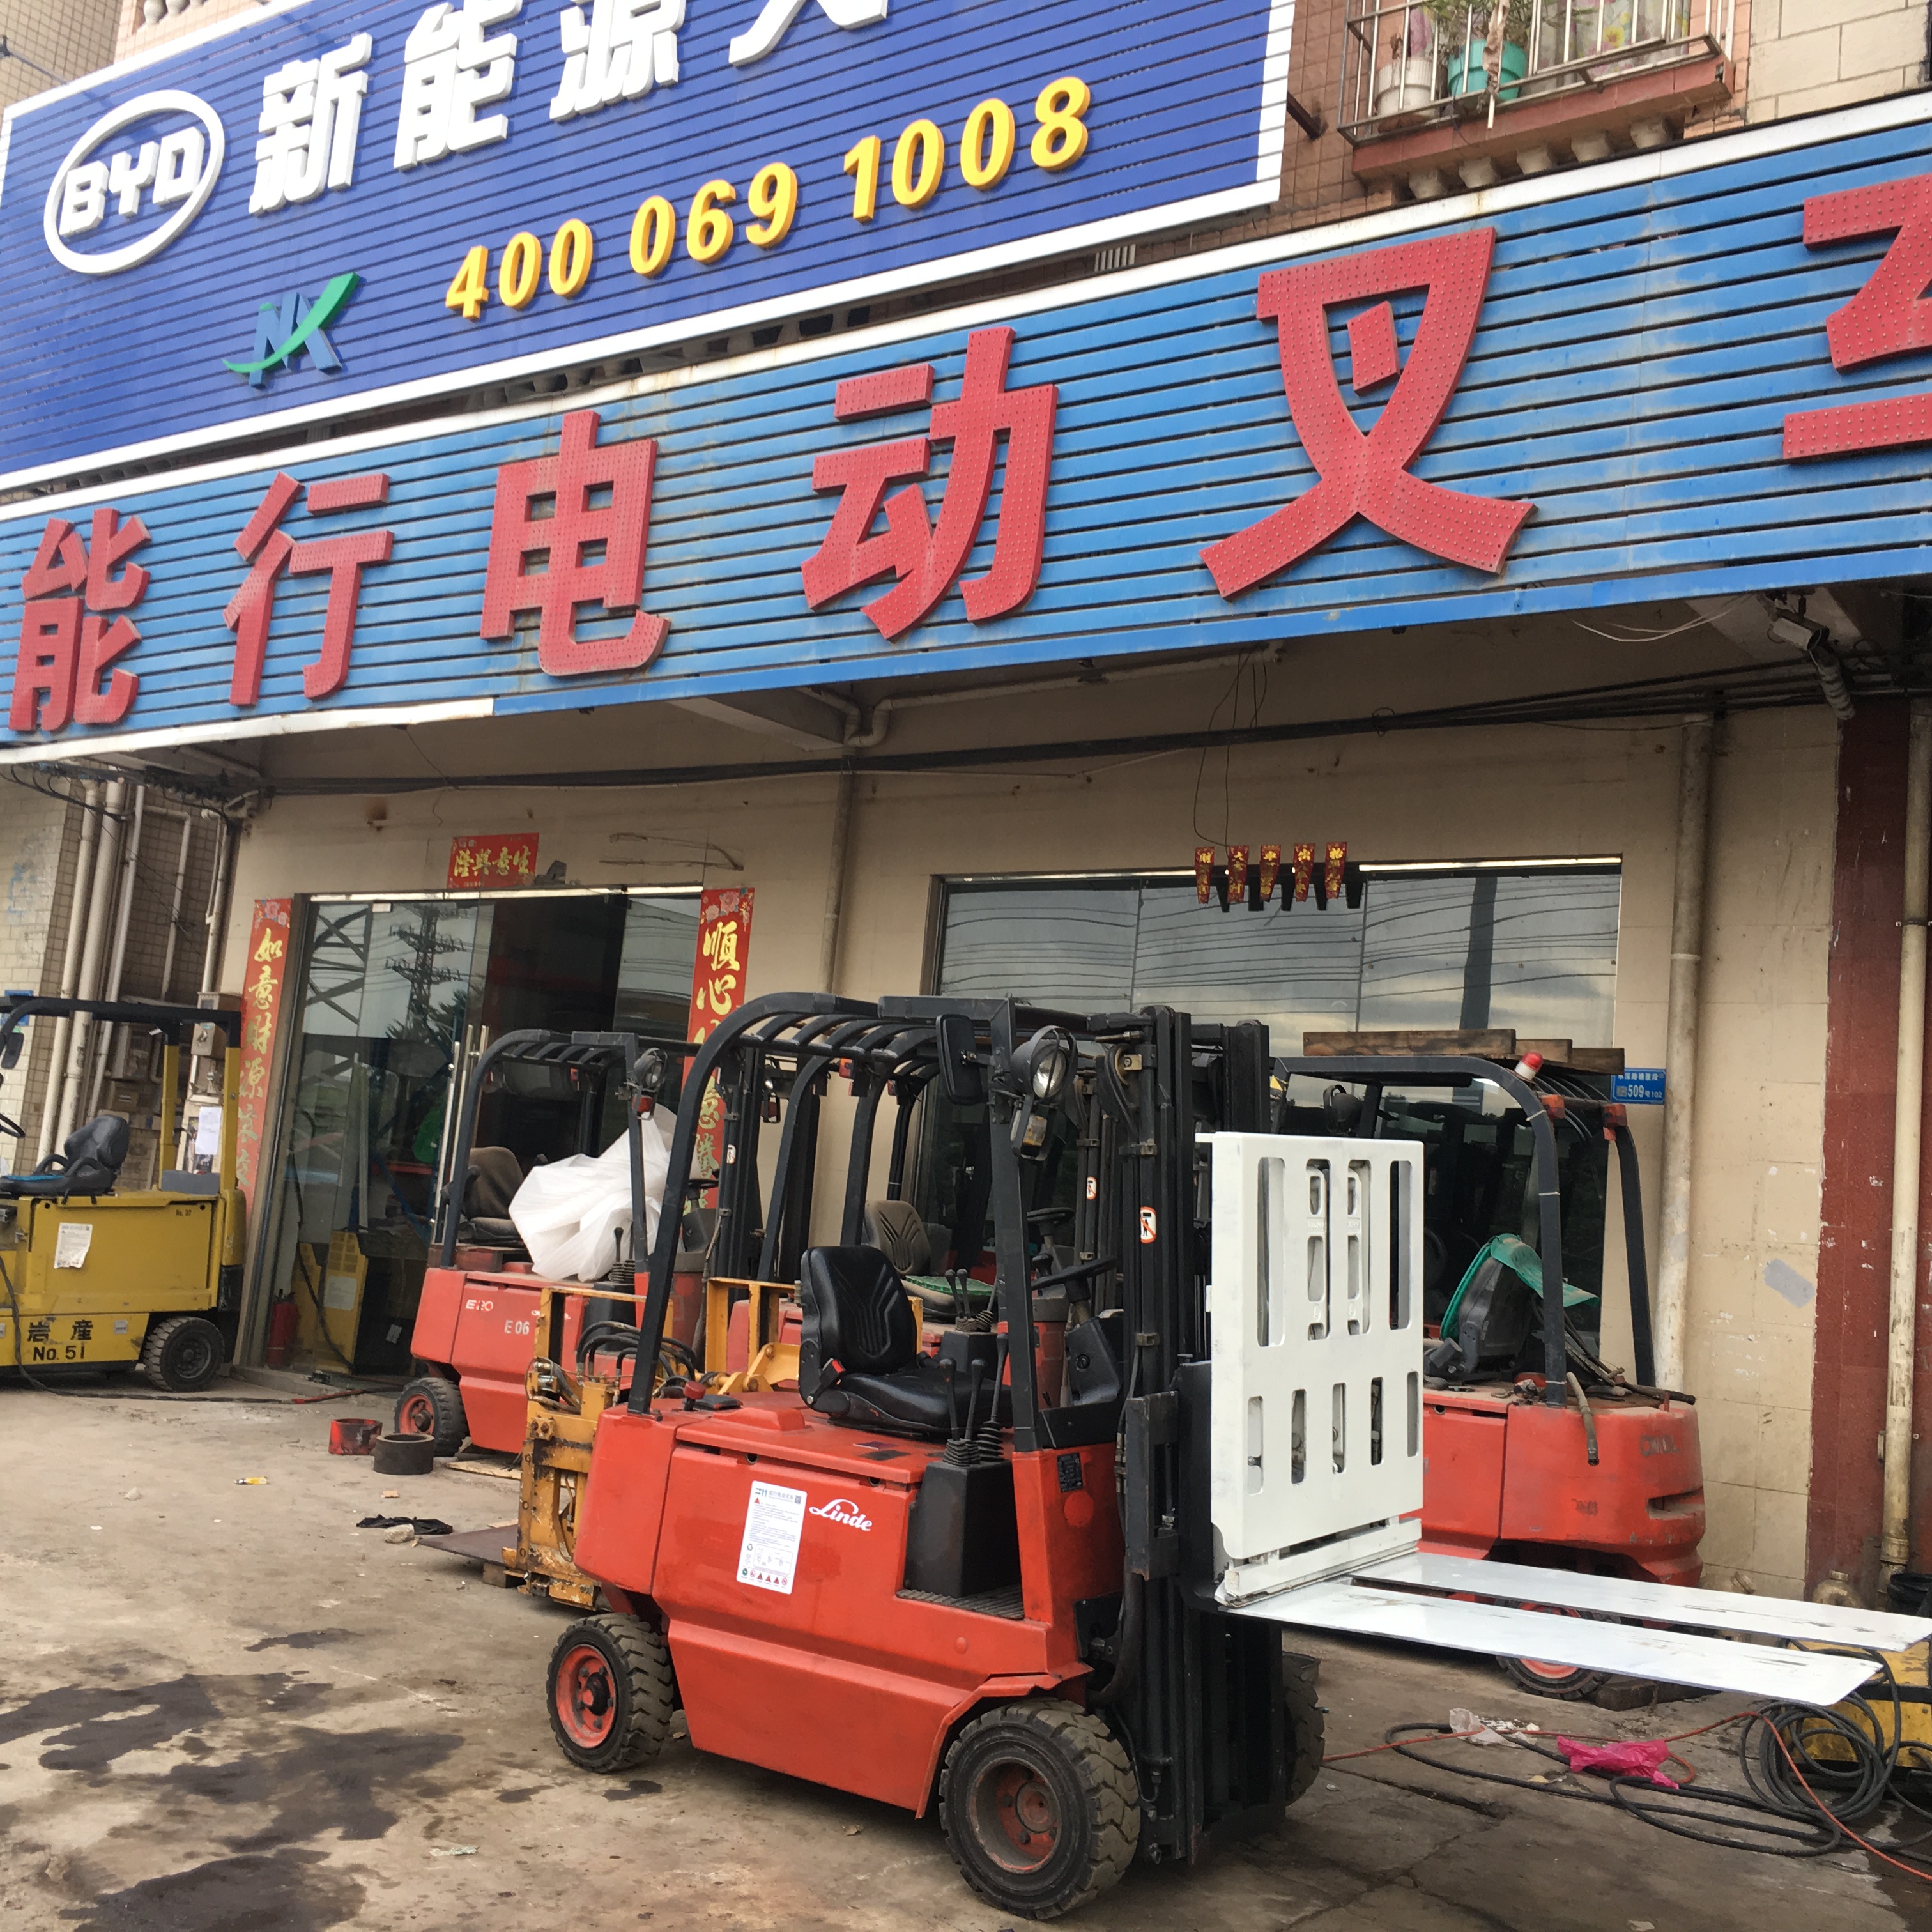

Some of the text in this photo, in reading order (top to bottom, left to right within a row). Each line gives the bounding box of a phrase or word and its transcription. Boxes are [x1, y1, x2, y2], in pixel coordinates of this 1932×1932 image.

[249, 0, 887, 215] 新能源
[59, 126, 205, 237] BYD
[445, 76, 1091, 320] 400 069 1008
[65, 1344, 85, 1360] 51
[504, 1319, 530, 1336] E 06
[808, 1498, 873, 1531] Linde
